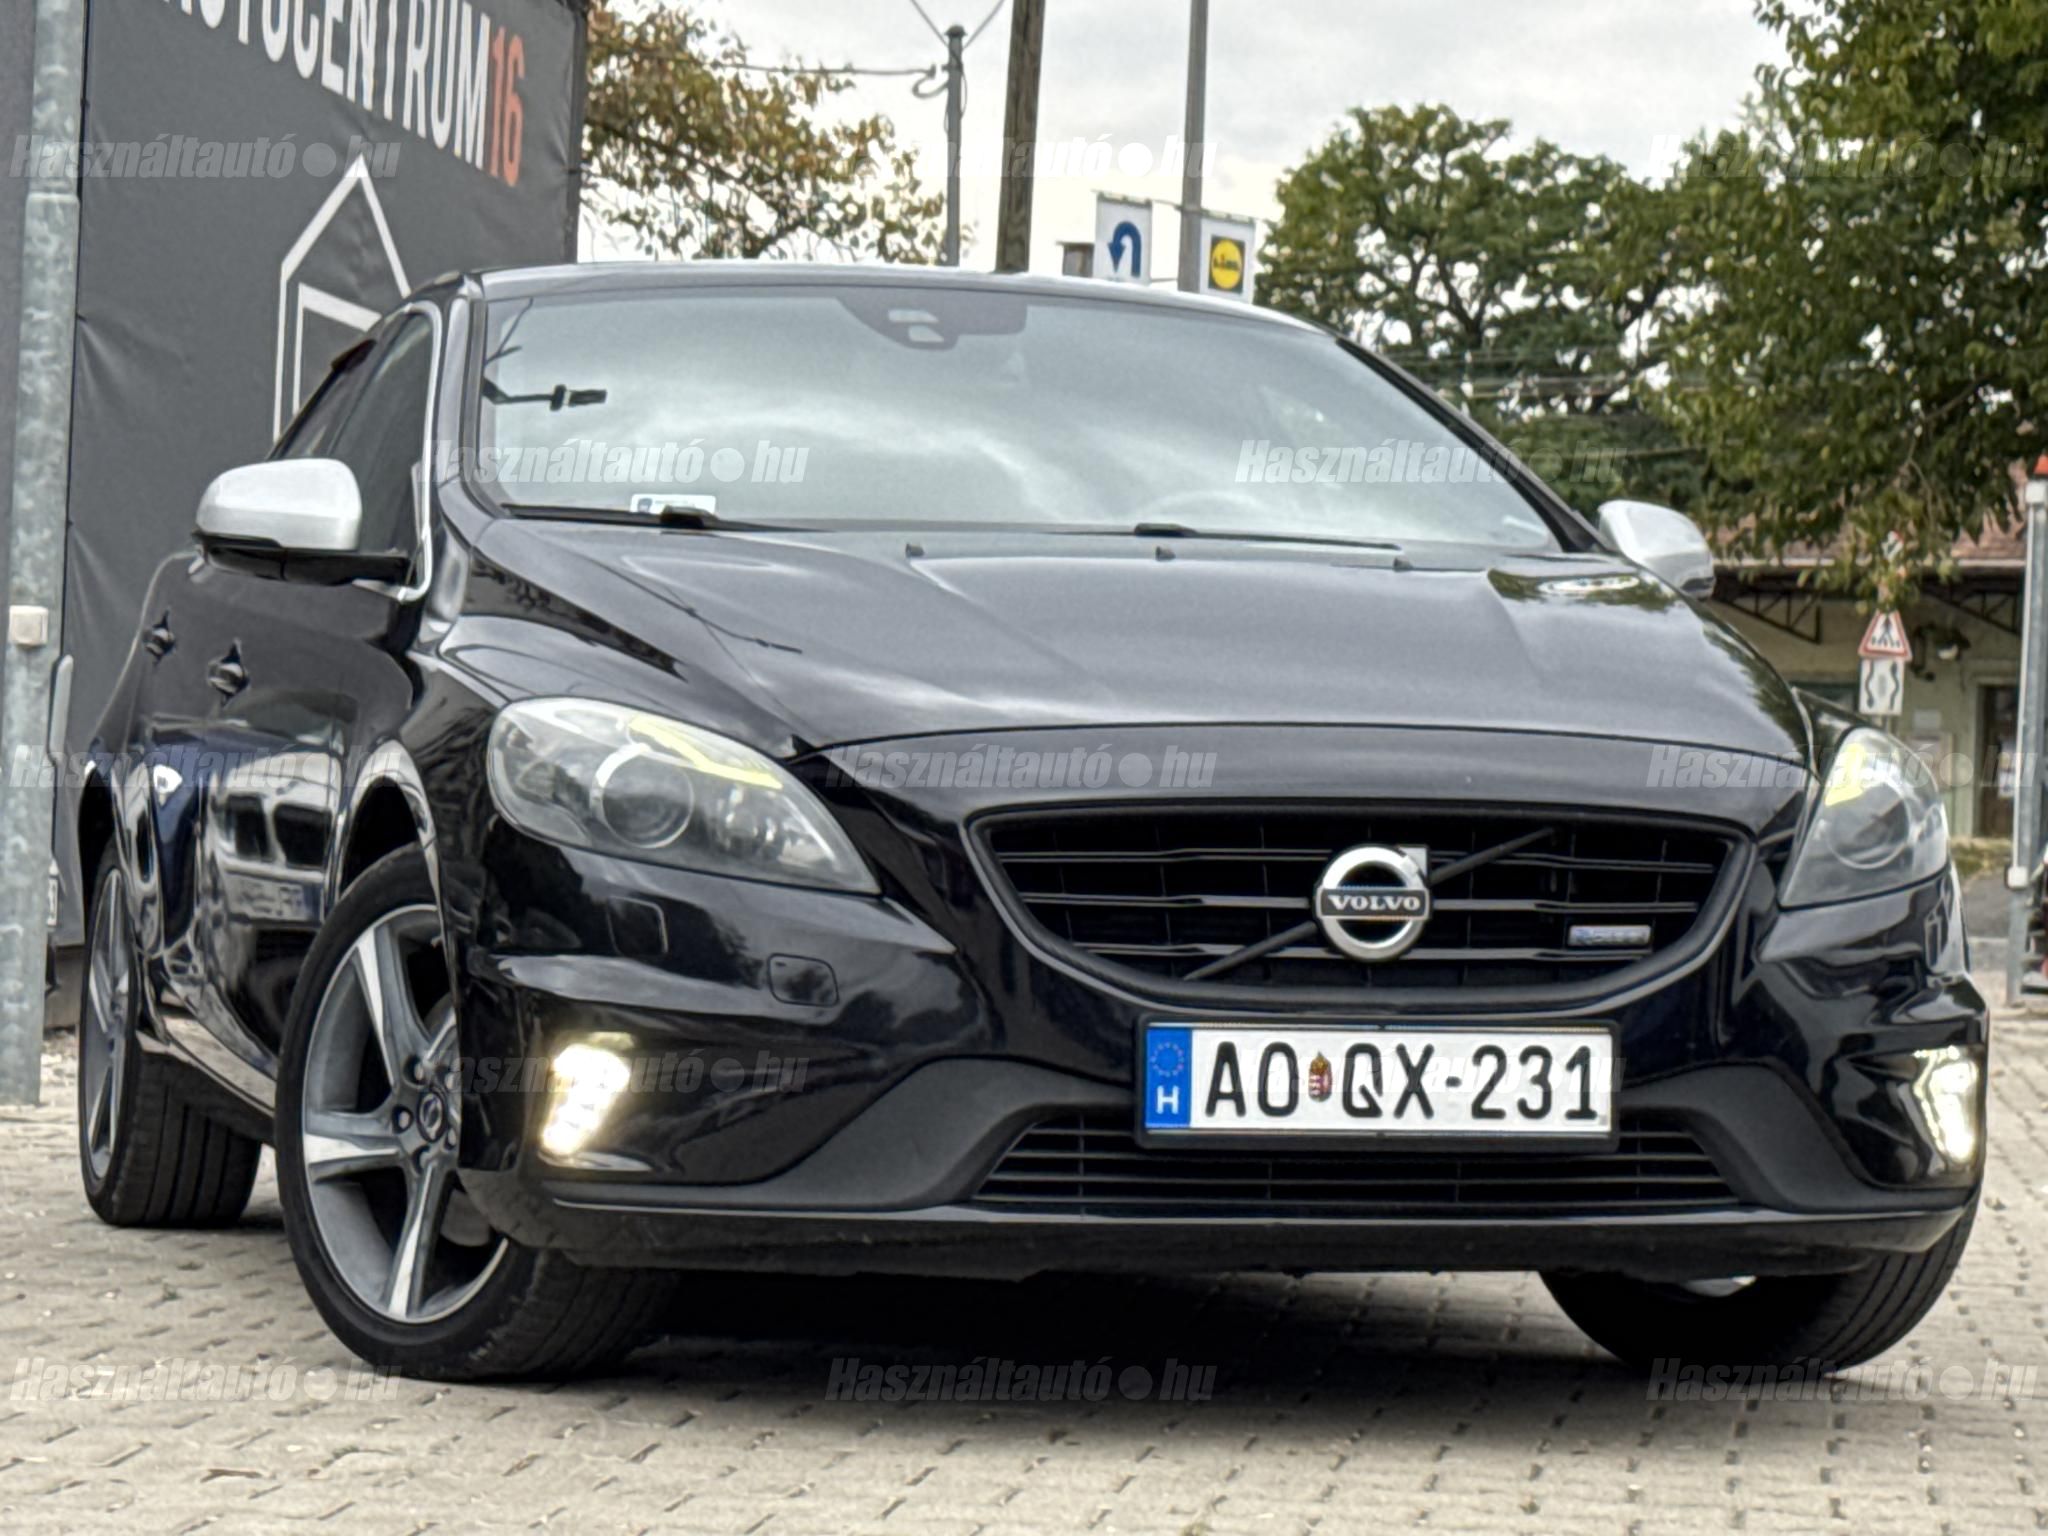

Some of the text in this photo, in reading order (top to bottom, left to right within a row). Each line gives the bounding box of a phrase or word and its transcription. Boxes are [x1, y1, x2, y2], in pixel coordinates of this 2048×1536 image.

[1328, 895, 1420, 910] VOLVO
[1204, 1041, 1598, 1120] AO QX-231
[1156, 1086, 1179, 1114] H
